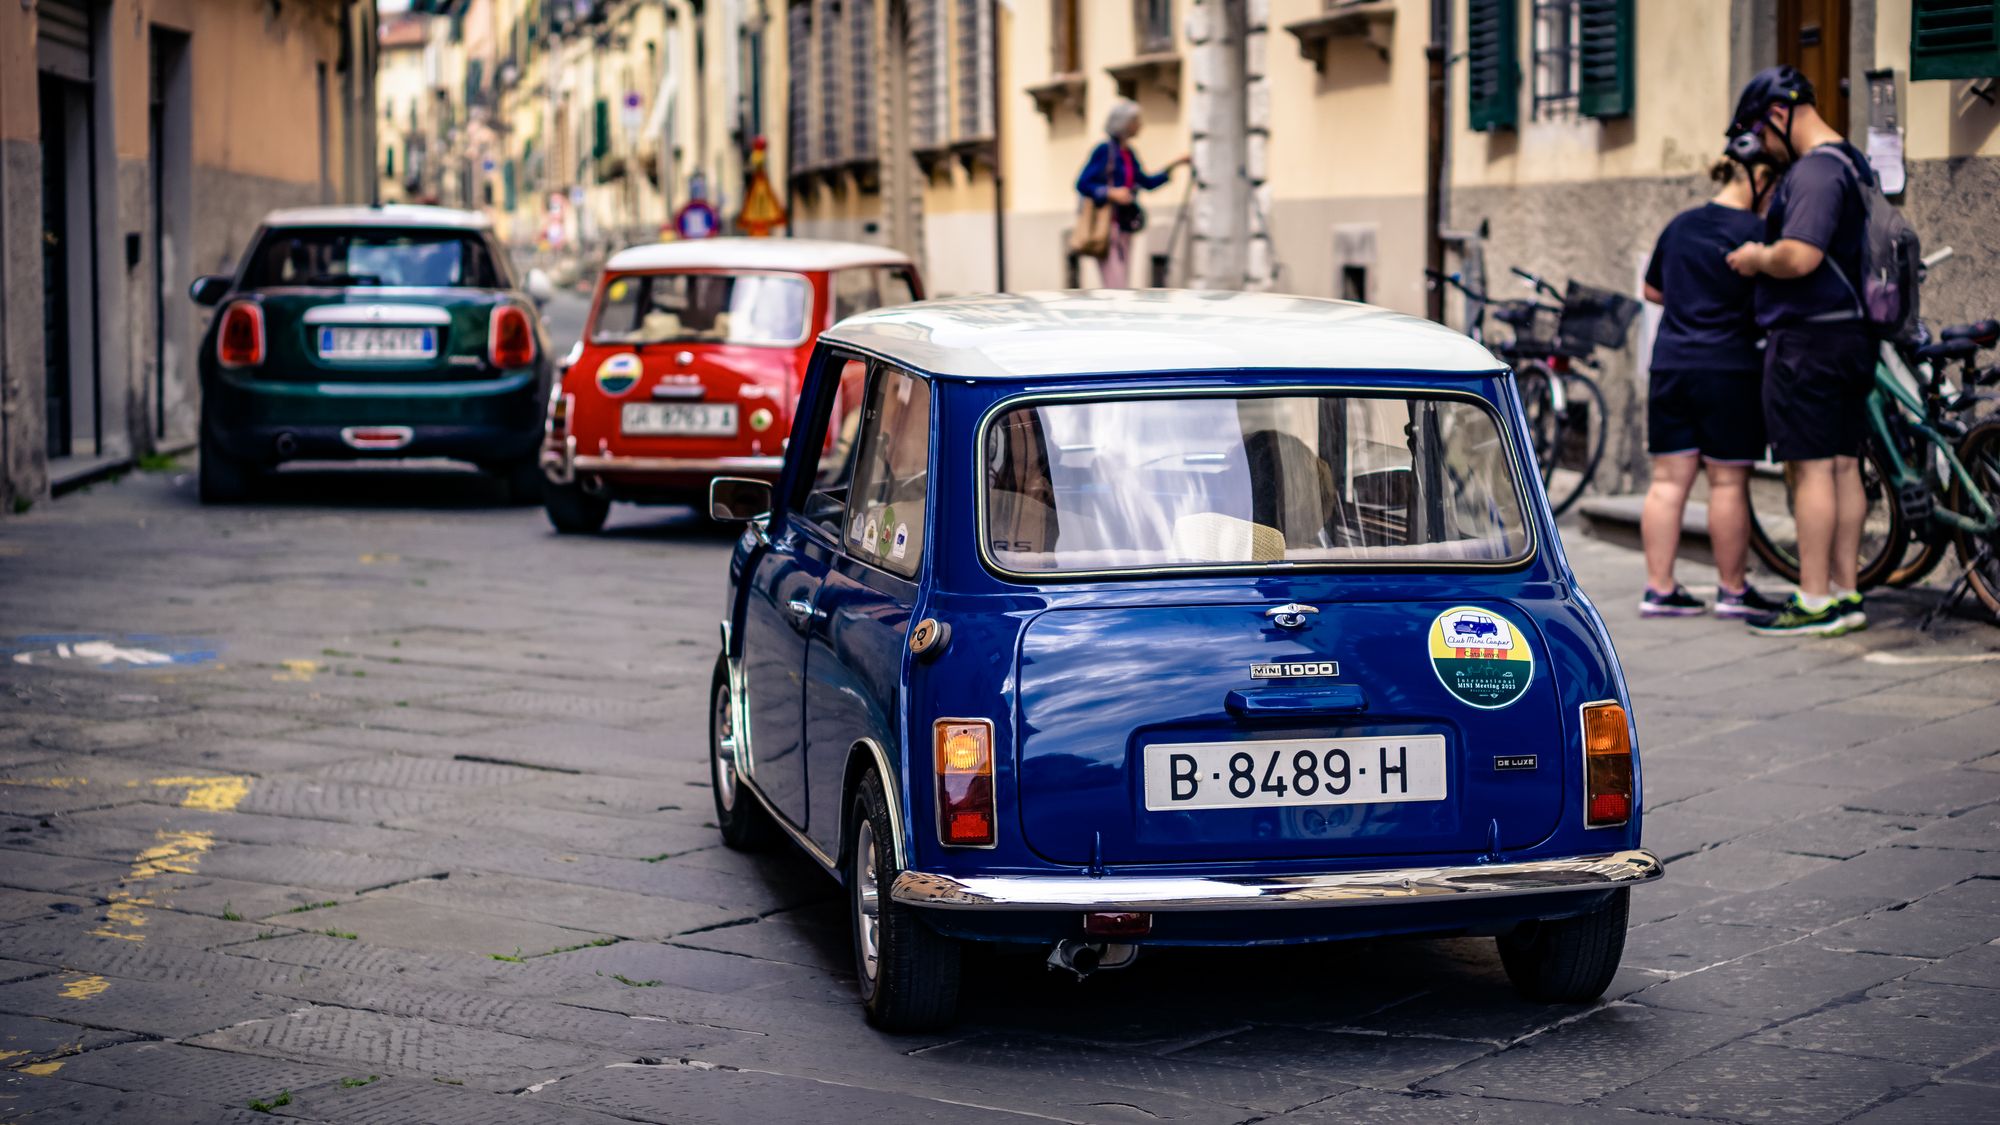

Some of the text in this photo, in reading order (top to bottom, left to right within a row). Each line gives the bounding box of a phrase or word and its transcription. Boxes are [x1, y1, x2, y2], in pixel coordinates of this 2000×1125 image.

[1447, 636, 1465, 644] Club
[1486, 637, 1510, 646] Cooper
[1464, 651, 1500, 659] Catalunya
[1254, 663, 1333, 676] MINI 1000
